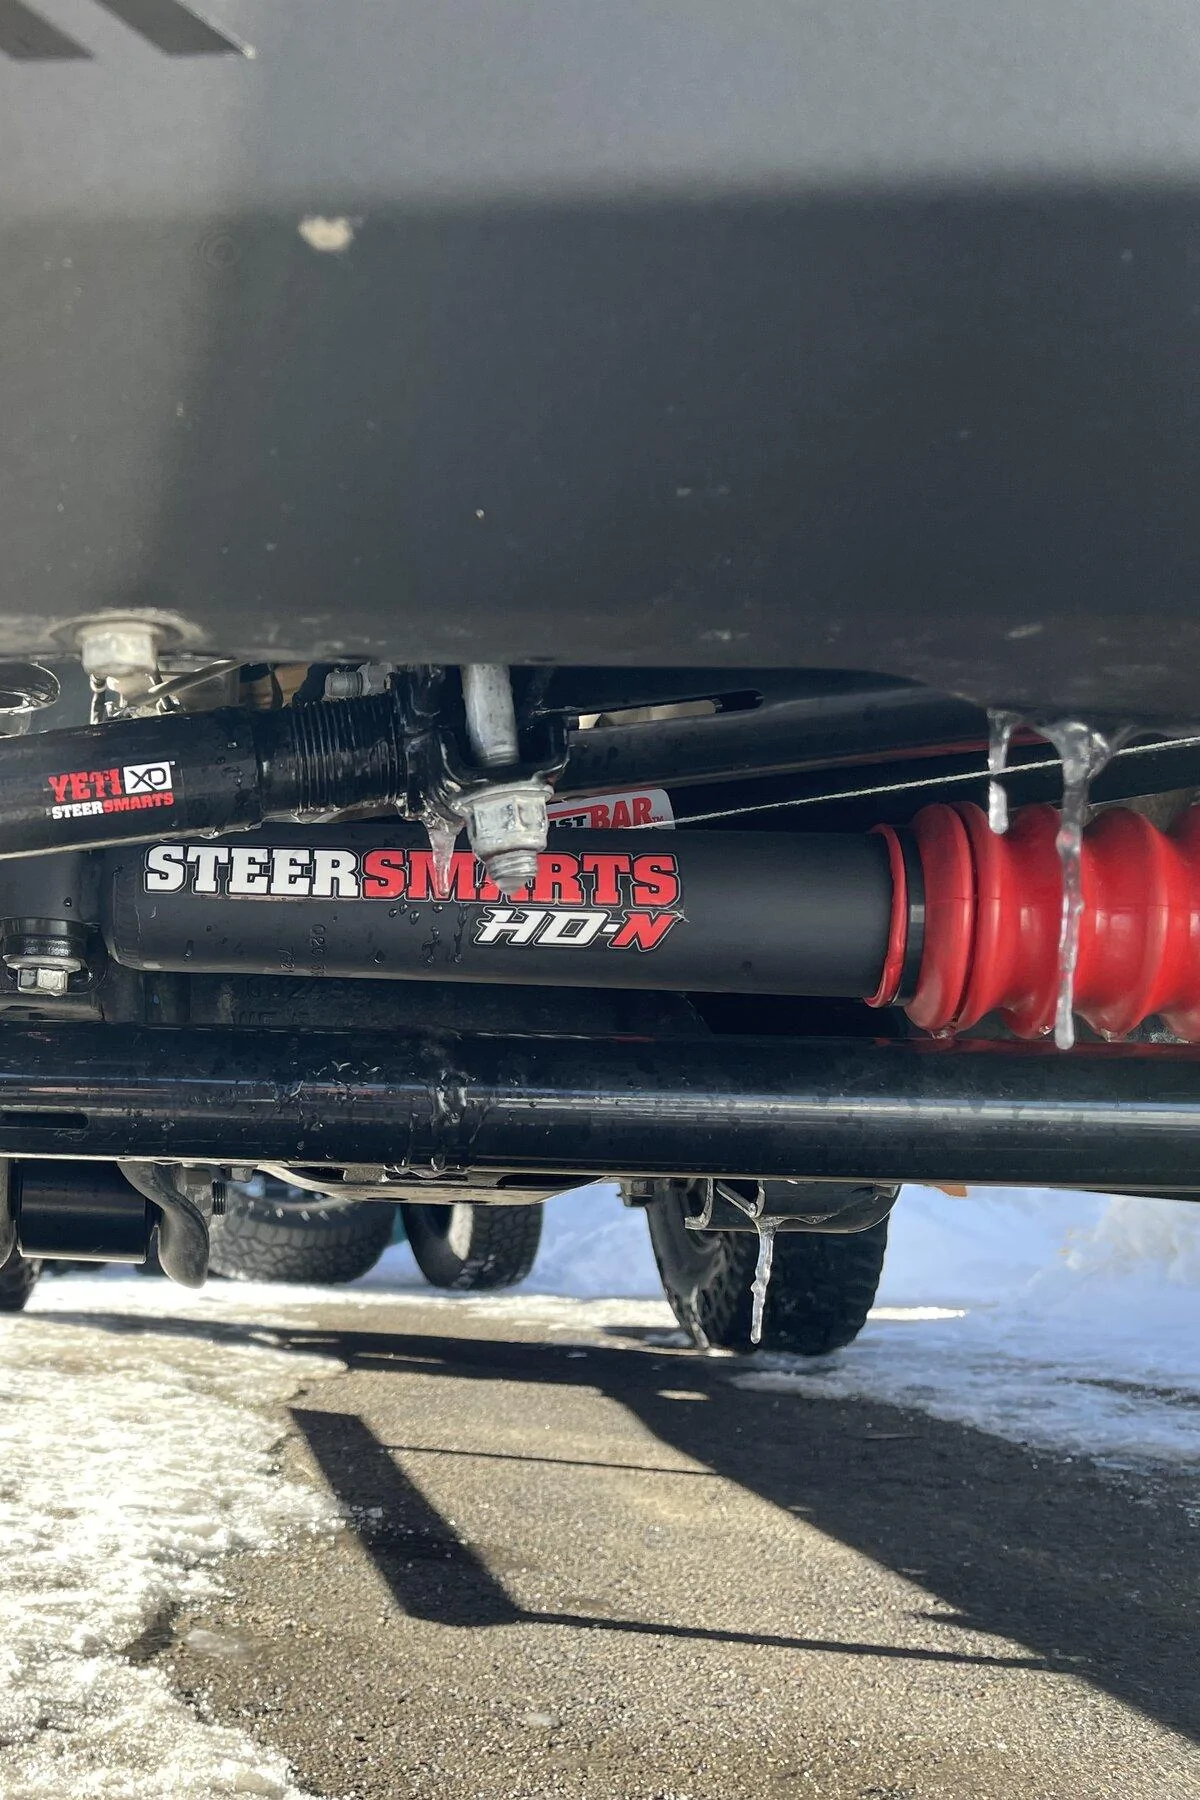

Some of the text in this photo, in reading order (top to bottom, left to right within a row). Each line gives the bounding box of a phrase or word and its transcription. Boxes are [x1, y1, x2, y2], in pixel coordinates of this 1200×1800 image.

[48, 768, 122, 803] YETI
[52, 792, 175, 820] STEERSMARTS
[590, 797, 653, 829] BAR
